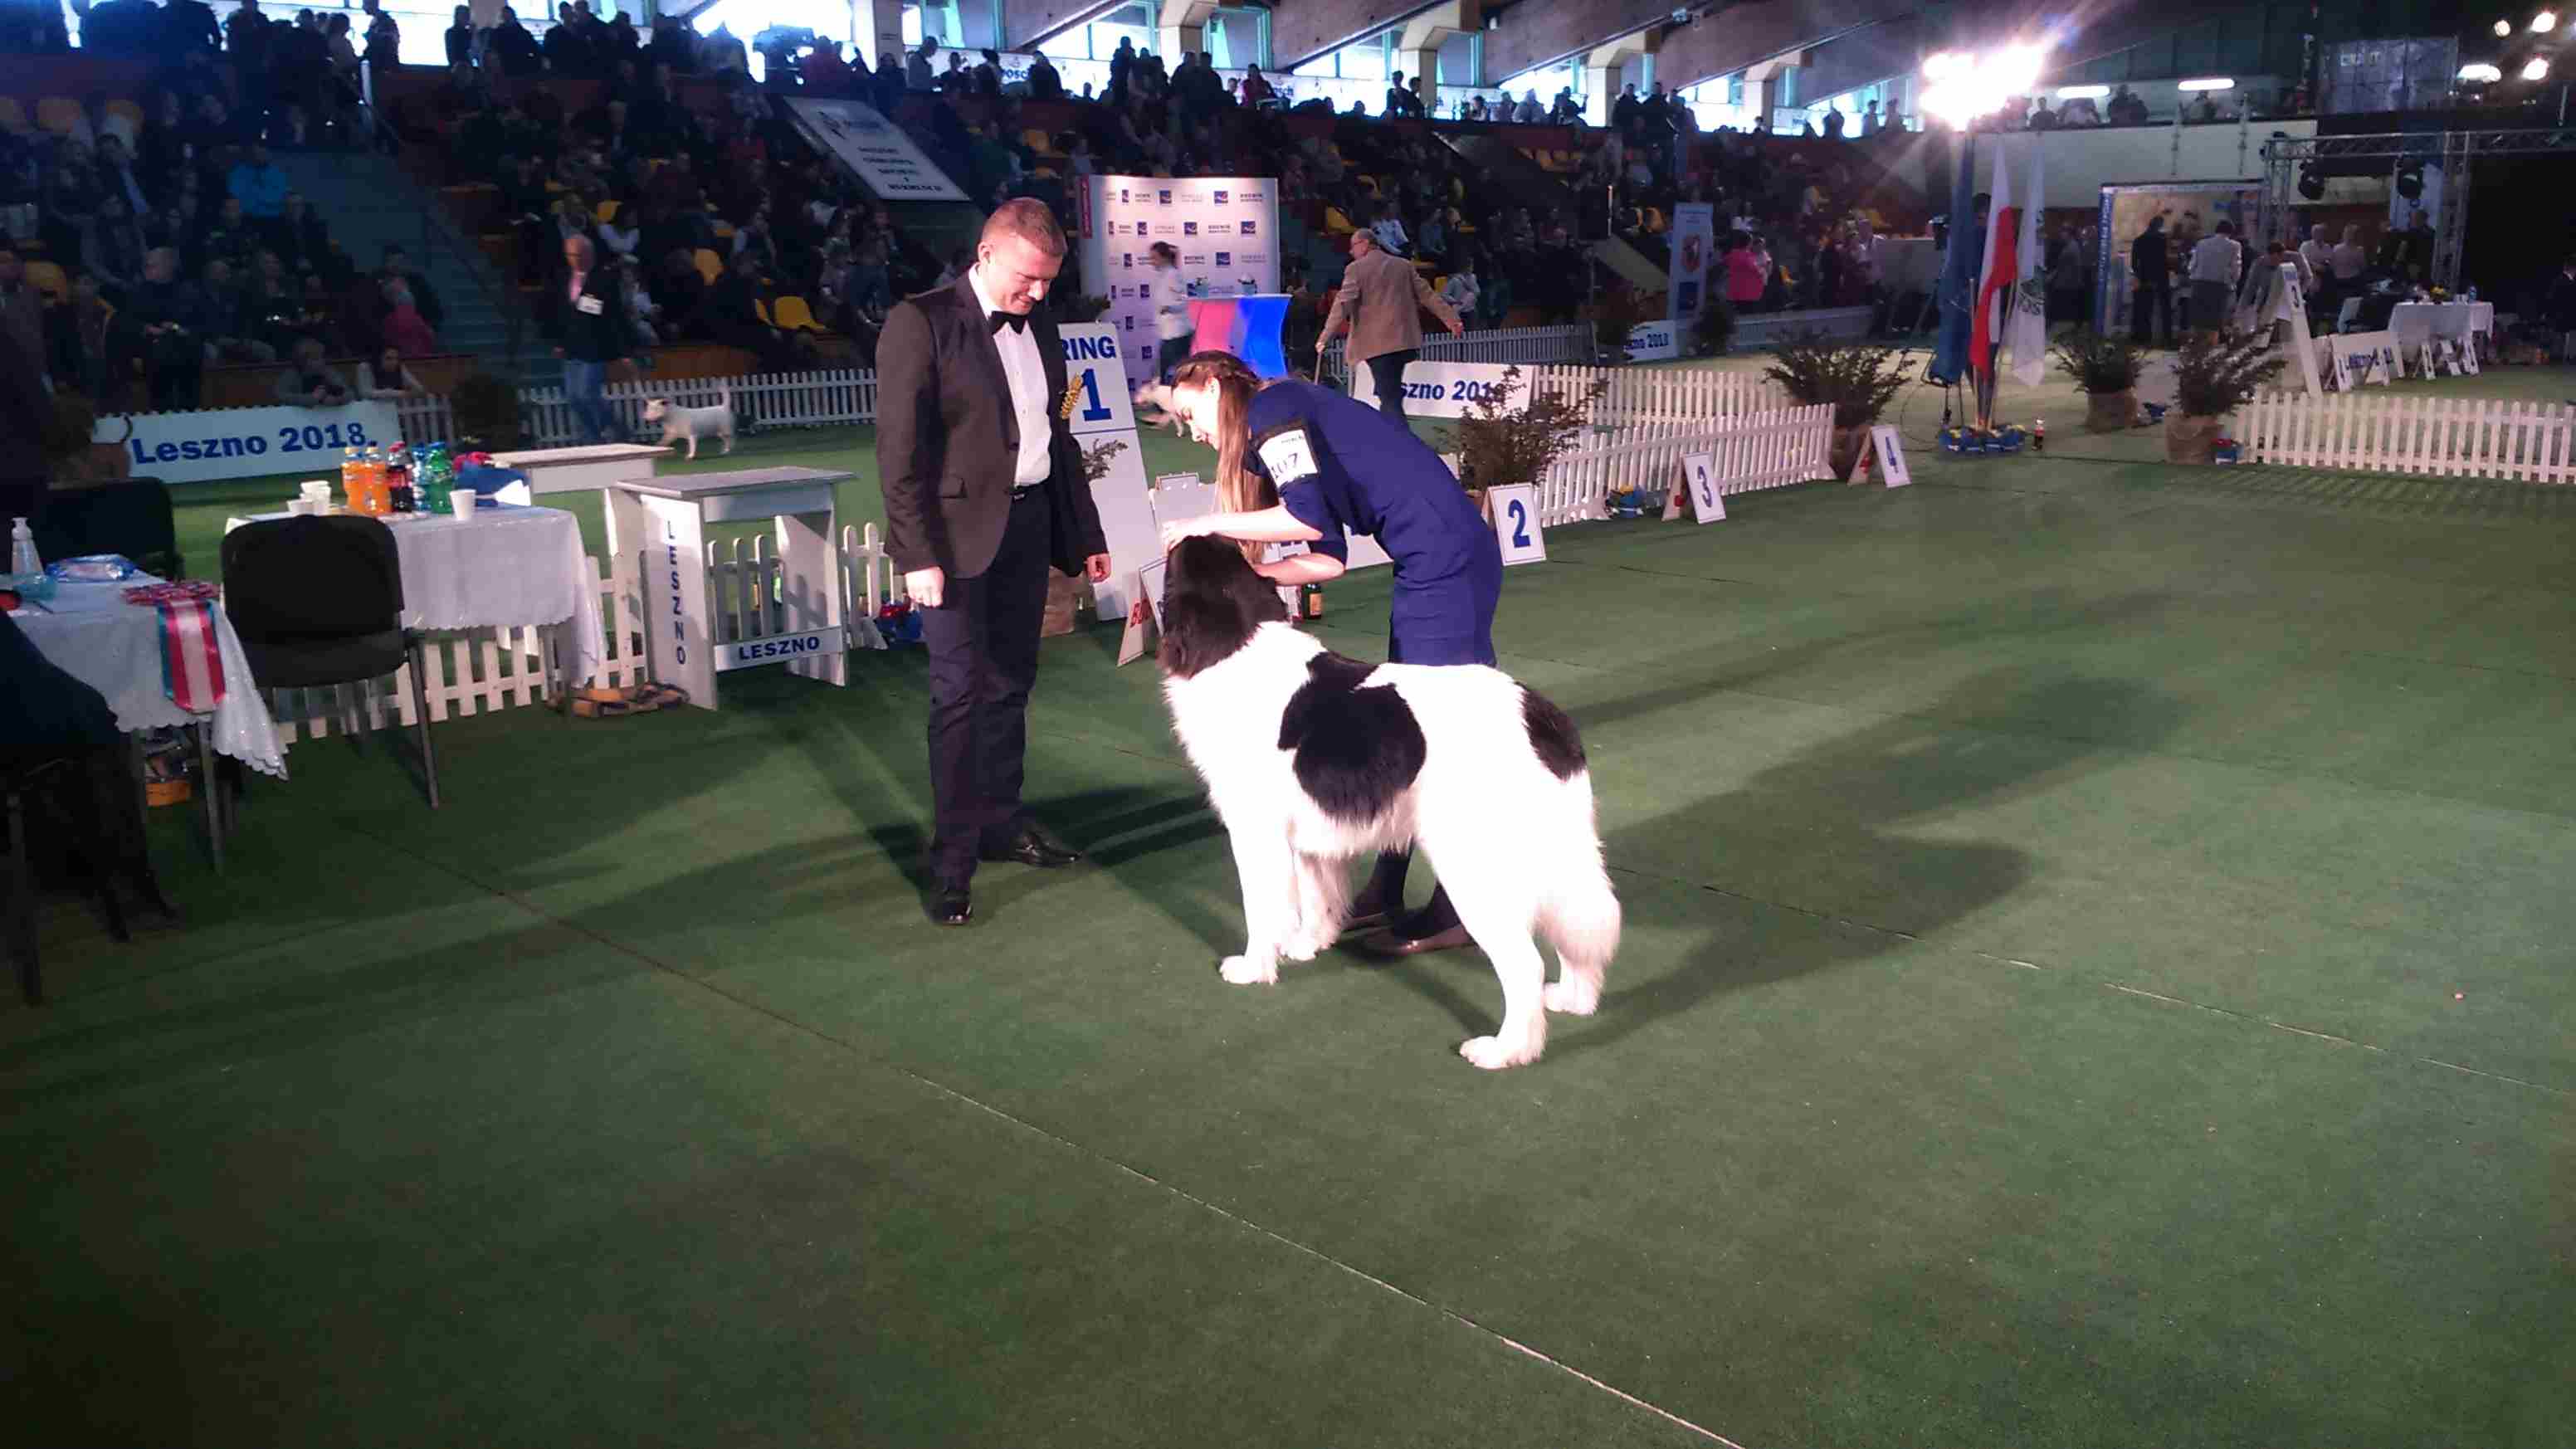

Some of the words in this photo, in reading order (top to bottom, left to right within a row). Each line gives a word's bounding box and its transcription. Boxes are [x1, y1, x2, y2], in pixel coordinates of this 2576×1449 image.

[1081, 368, 1112, 422] 1
[130, 435, 267, 464] Leszno
[1885, 436, 1899, 474] 4
[1697, 465, 1712, 508] 3
[1508, 499, 1531, 548] 2
[666, 520, 687, 665] LESZNO
[739, 636, 820, 661] LESZNO
